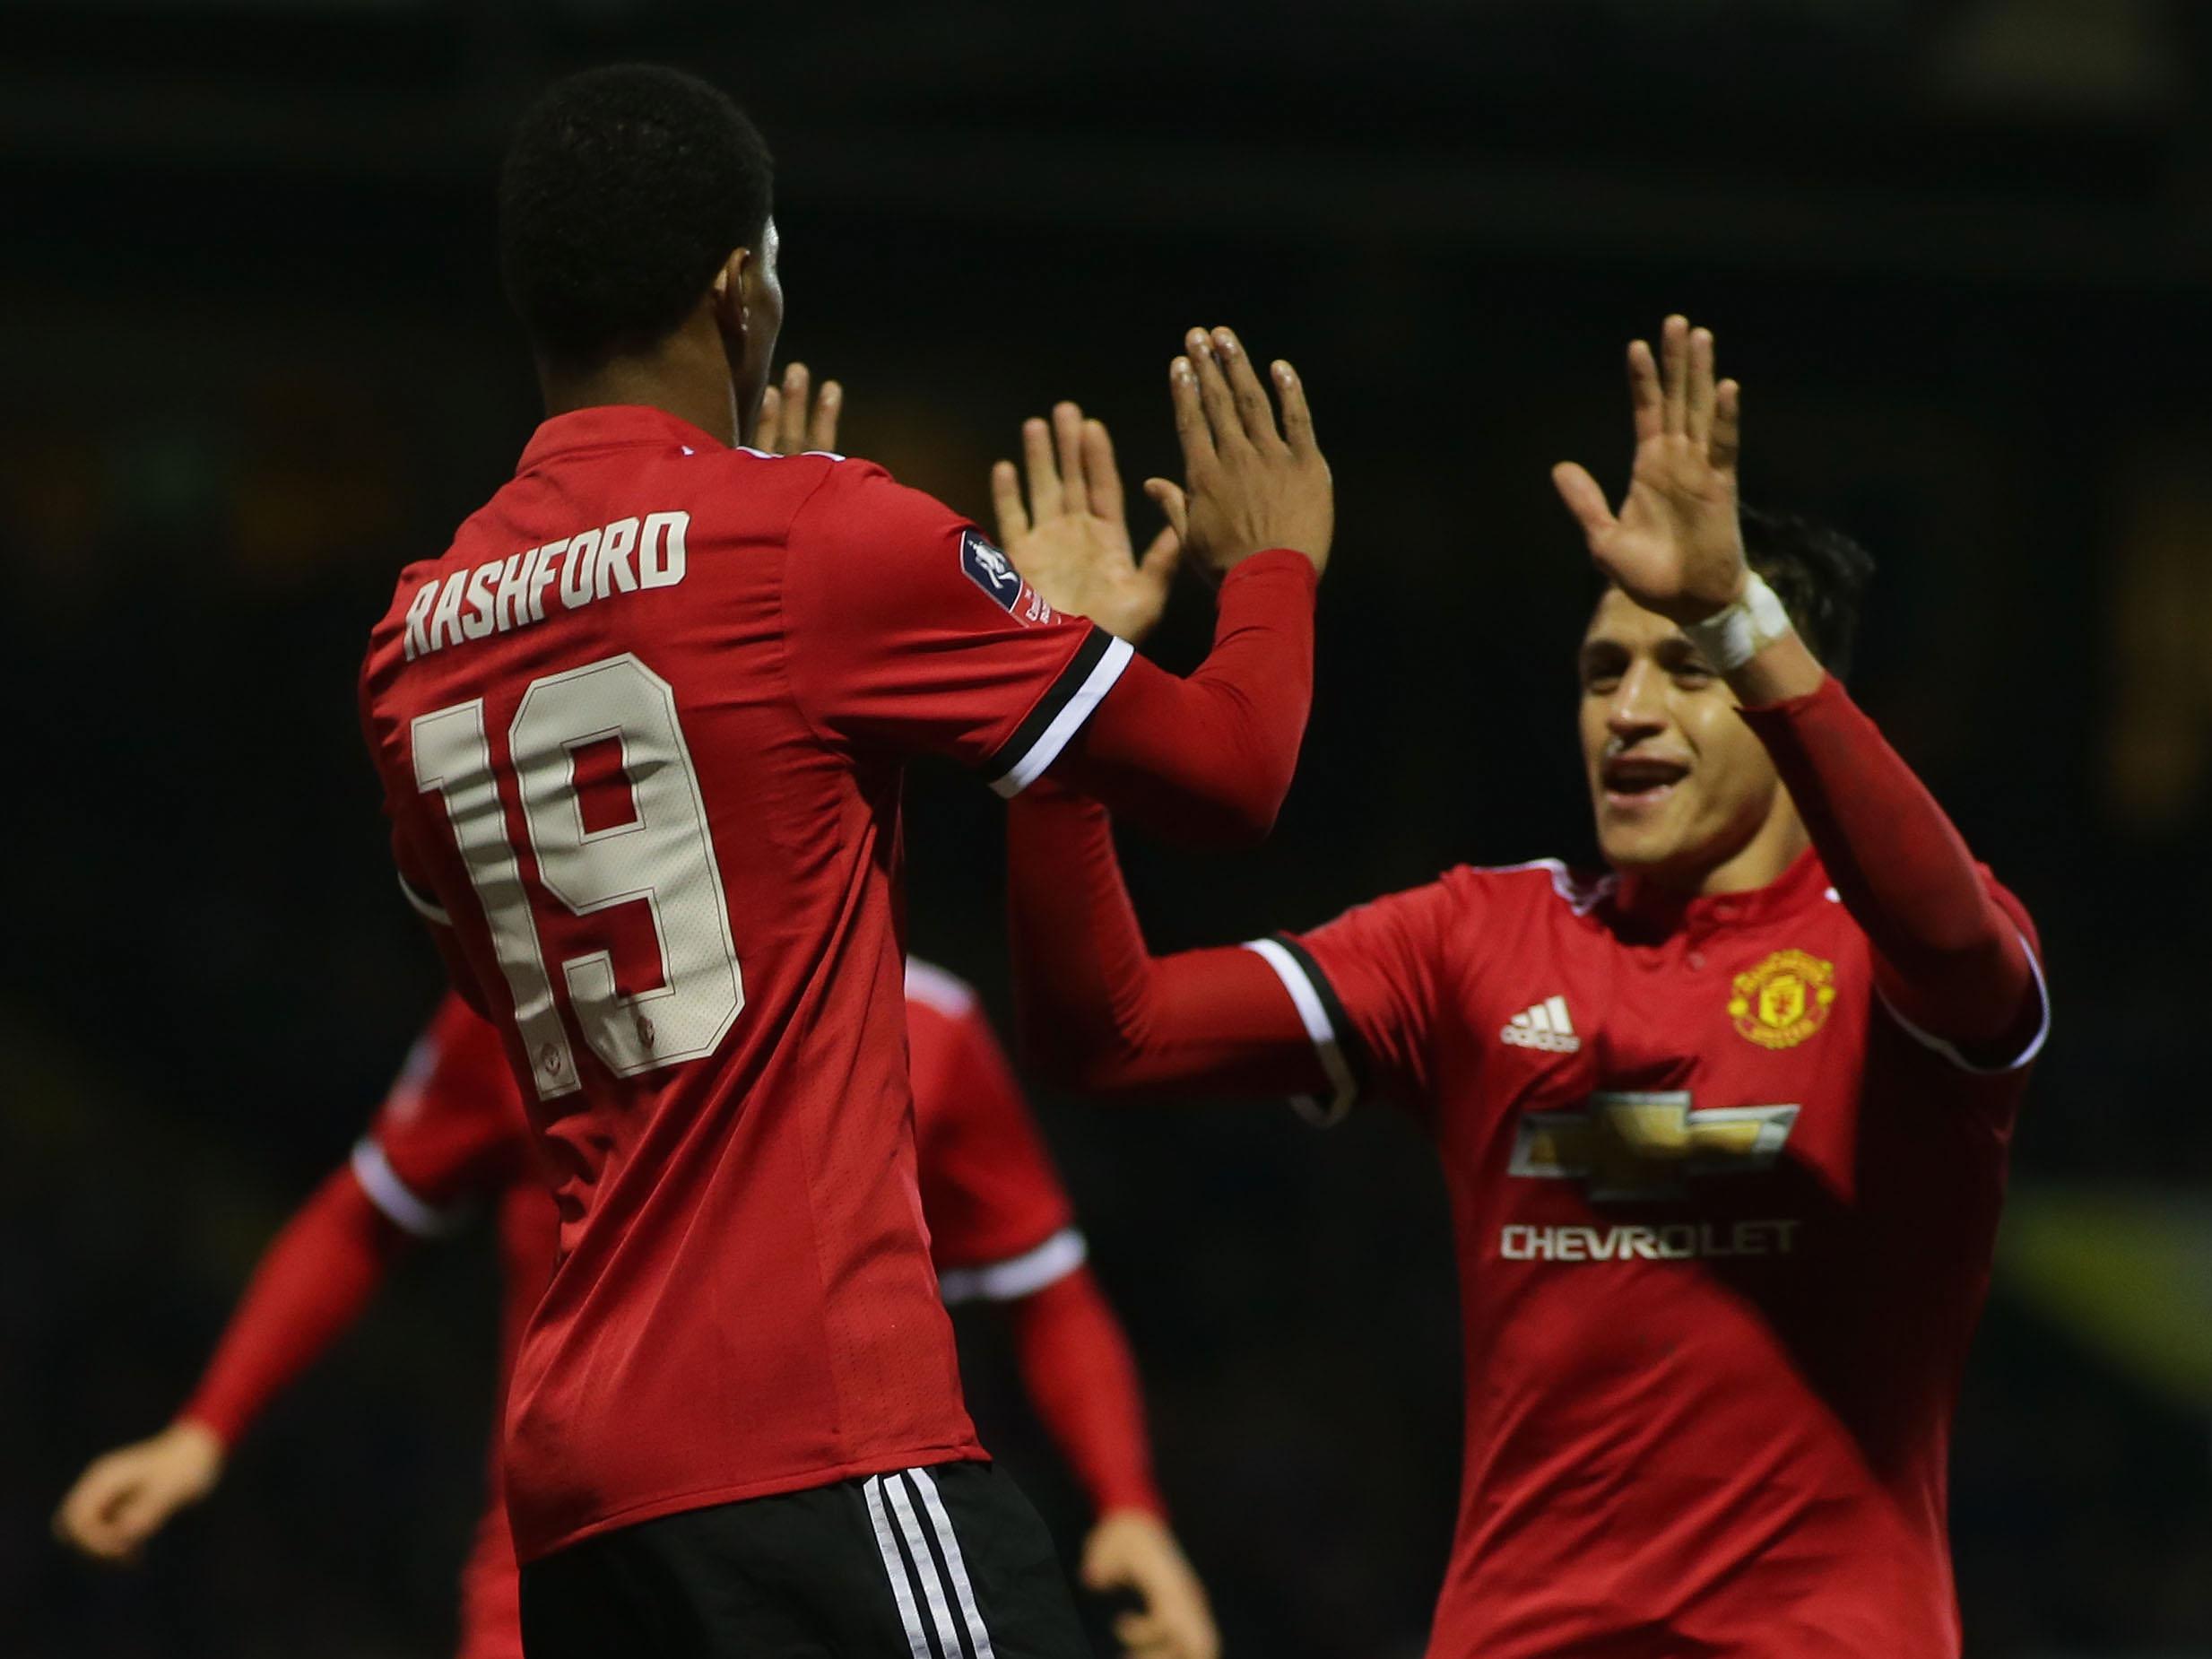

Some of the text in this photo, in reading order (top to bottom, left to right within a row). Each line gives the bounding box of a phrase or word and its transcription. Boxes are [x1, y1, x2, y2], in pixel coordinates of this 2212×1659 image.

[404, 510, 690, 662] RASHFORD
[411, 652, 745, 1101] 19
[1499, 1220, 1799, 1262] CHEVROLET
